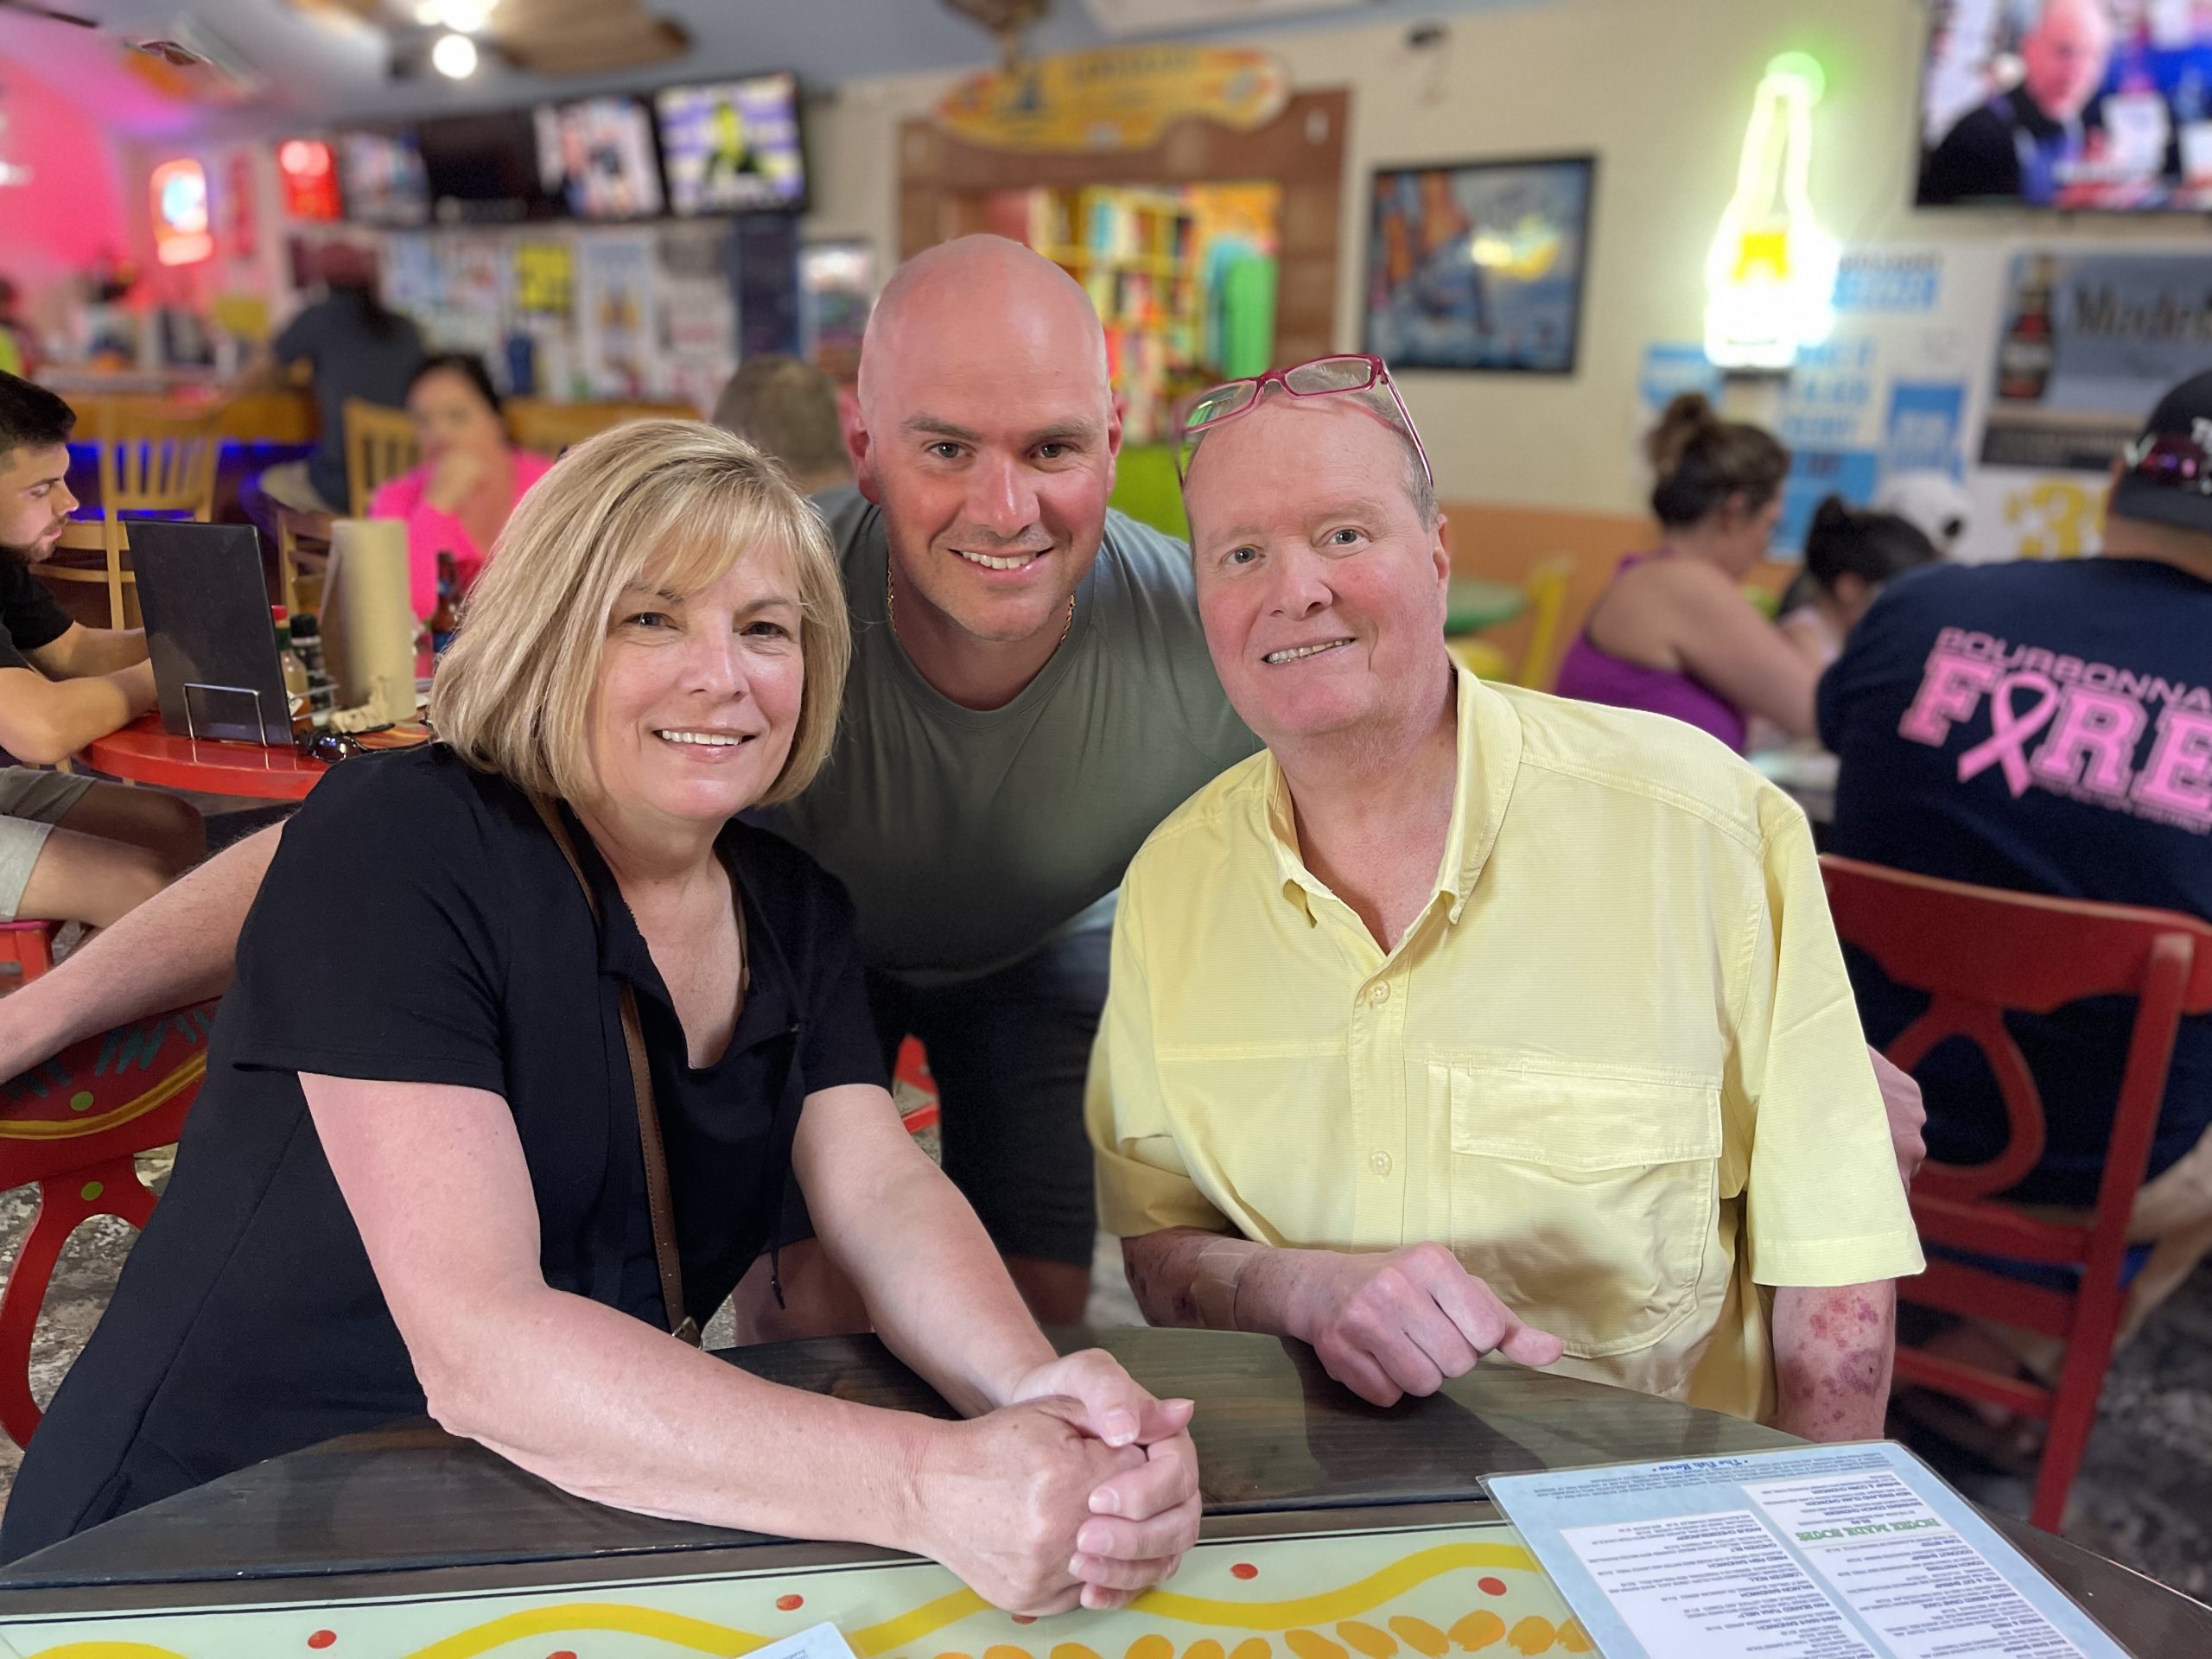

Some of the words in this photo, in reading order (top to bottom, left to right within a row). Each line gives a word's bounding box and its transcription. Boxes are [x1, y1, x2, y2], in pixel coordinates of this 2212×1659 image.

[1656, 1463, 1693, 1472] House
[1691, 1460, 1719, 1469] Fish
[1716, 1459, 1743, 1467] The
[1841, 1522, 1892, 1536] MADE
[1887, 1517, 1942, 1531] HOUSE
[1793, 1528, 1846, 1541] SOUPS
